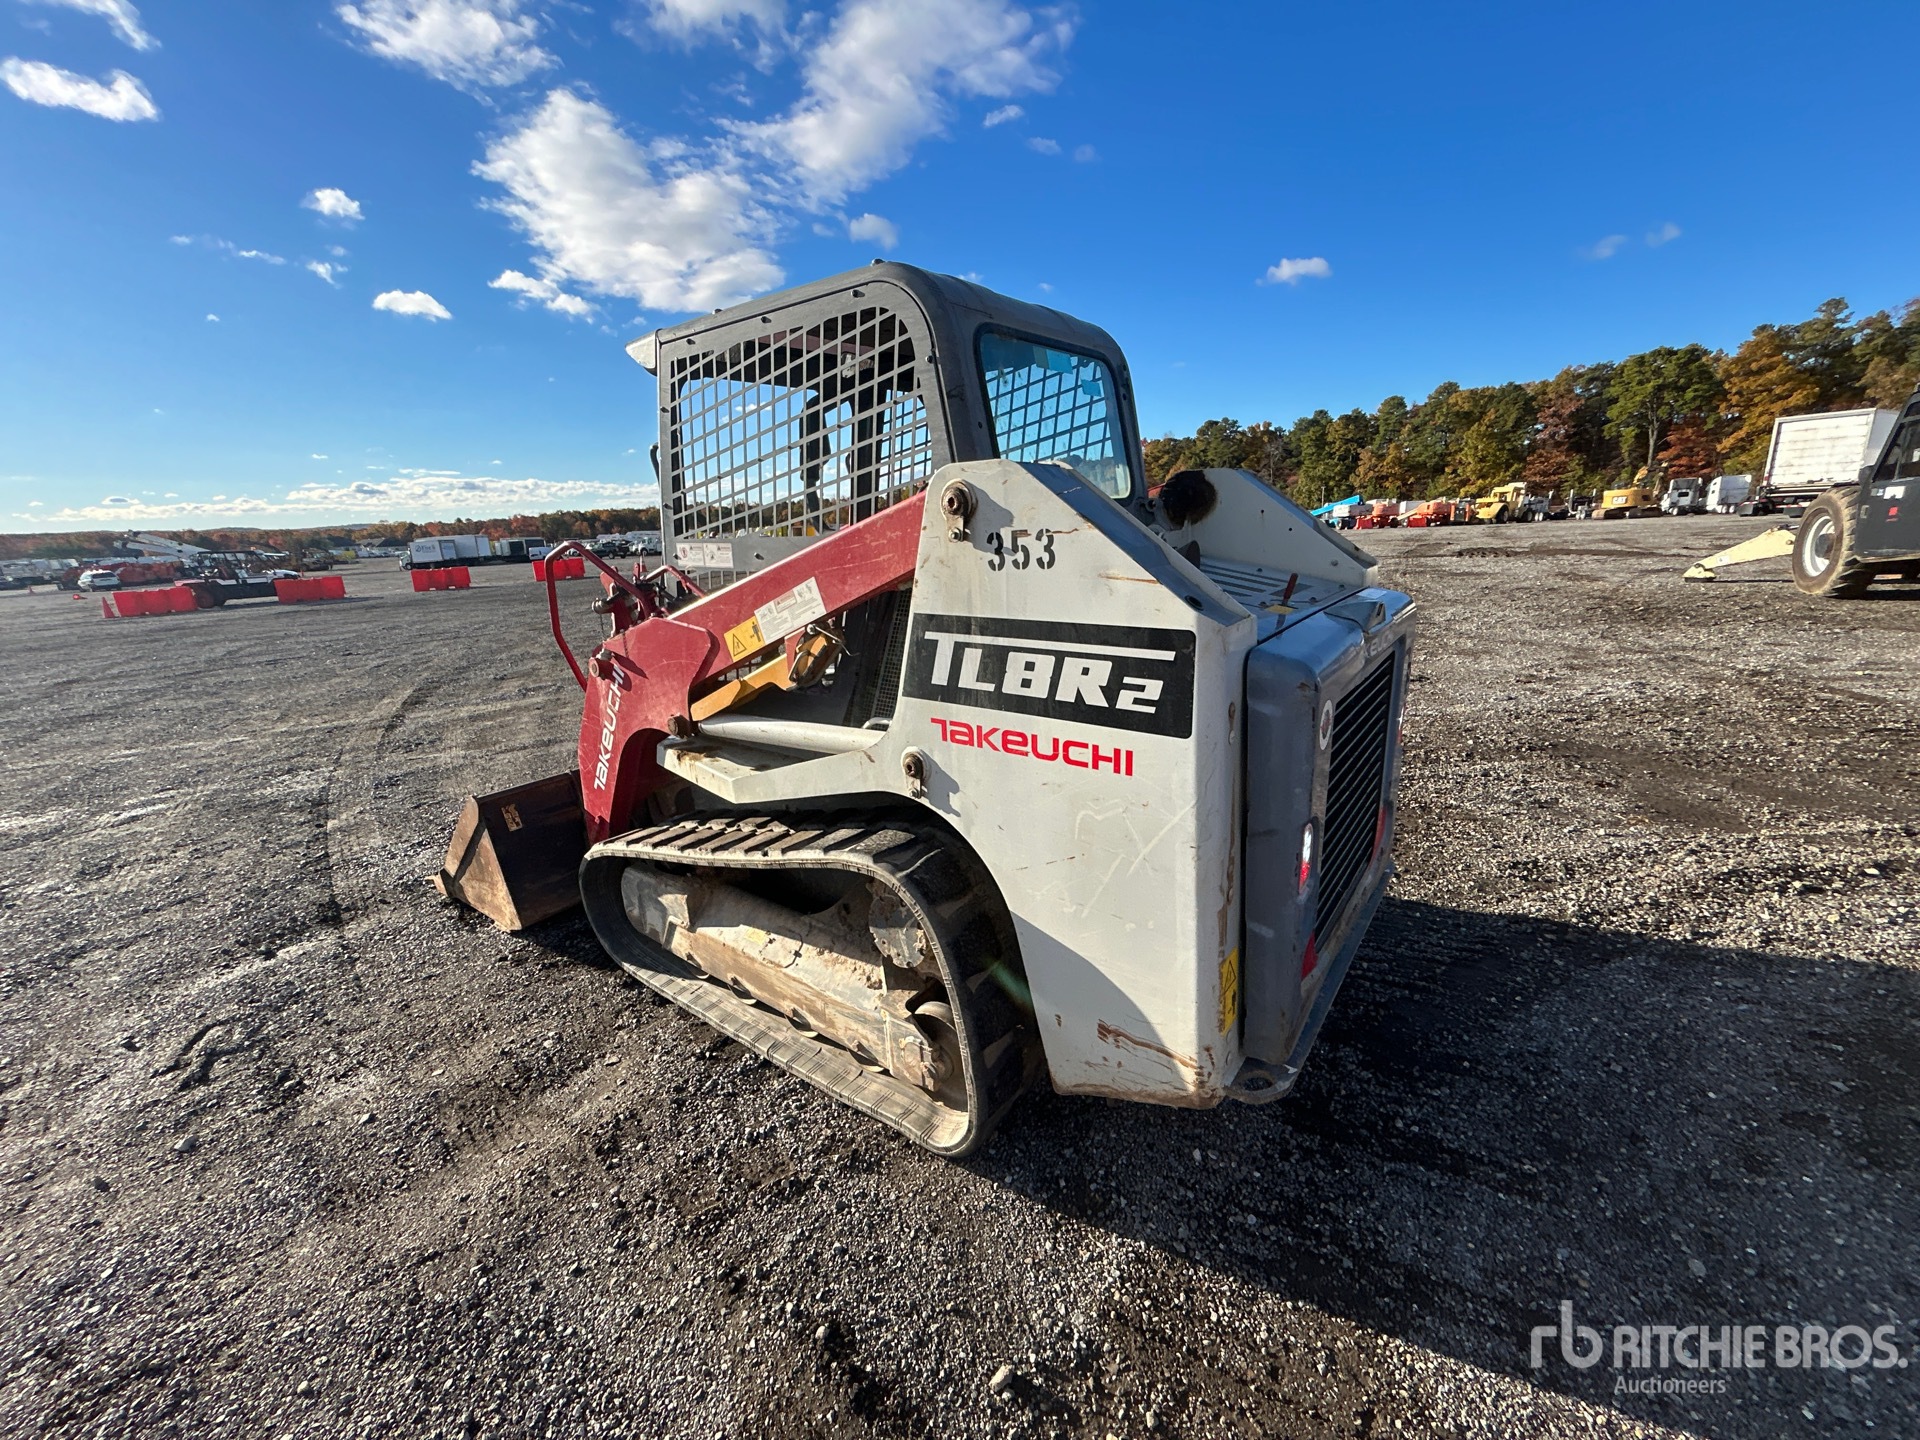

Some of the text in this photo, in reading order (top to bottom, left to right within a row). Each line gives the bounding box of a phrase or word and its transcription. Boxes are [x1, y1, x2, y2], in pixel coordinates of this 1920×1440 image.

[985, 528, 1056, 572] 353
[924, 630, 1176, 714] TL8R2
[593, 663, 625, 791] TAKEUCHI
[930, 717, 1134, 777] TAKEUCHI
